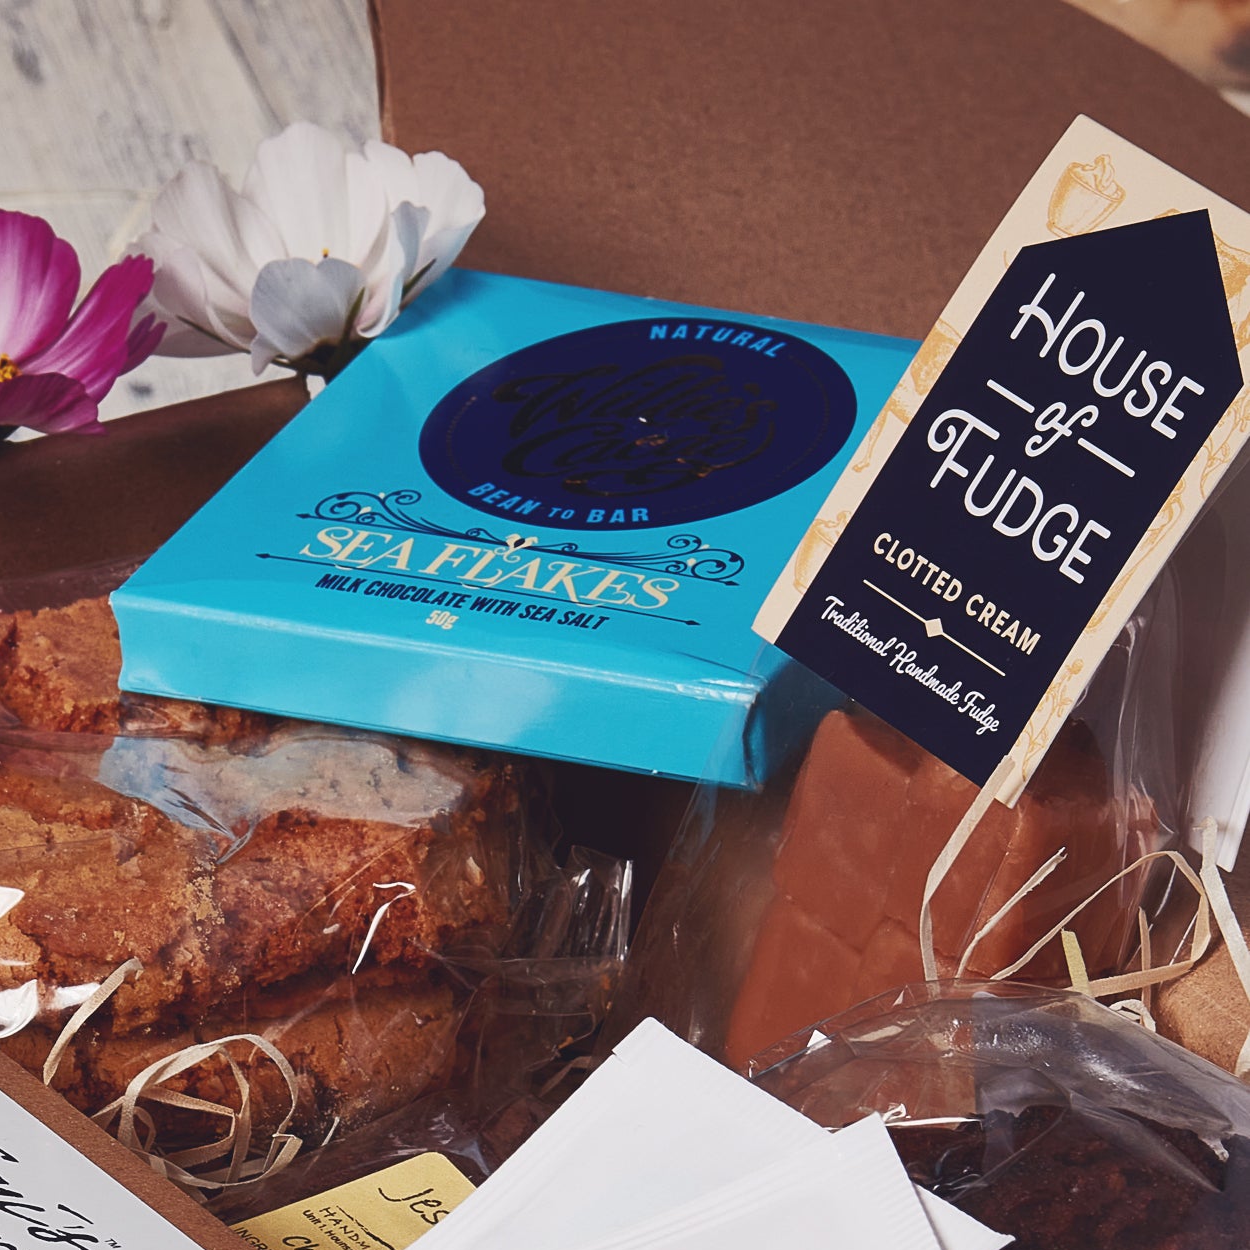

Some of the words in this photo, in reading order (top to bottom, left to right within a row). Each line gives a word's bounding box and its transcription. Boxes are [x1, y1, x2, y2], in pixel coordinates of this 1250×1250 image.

[650, 324, 789, 358] NATURAL
[1010, 272, 1205, 440] HOUSE
[1025, 401, 1100, 458] of
[467, 482, 541, 516] BEAN
[586, 507, 650, 523] BAR
[926, 409, 1111, 584] FUDGE
[299, 526, 412, 571] SEA
[418, 542, 680, 610] FLAKES
[873, 533, 963, 602] CLOTTED
[965, 594, 1041, 656] CREAM
[315, 573, 365, 593] MILK
[364, 580, 467, 610] CHOCOLATE
[470, 595, 521, 617] WITH
[519, 602, 558, 624] SEA
[558, 610, 610, 631] SALT
[425, 608, 459, 630] 50g
[820, 595, 897, 657] Traditional
[889, 643, 963, 705] Handmade
[958, 691, 1000, 735] Fudge
[302, 1209, 322, 1225] Unit
[378, 1188, 451, 1226] Jes
